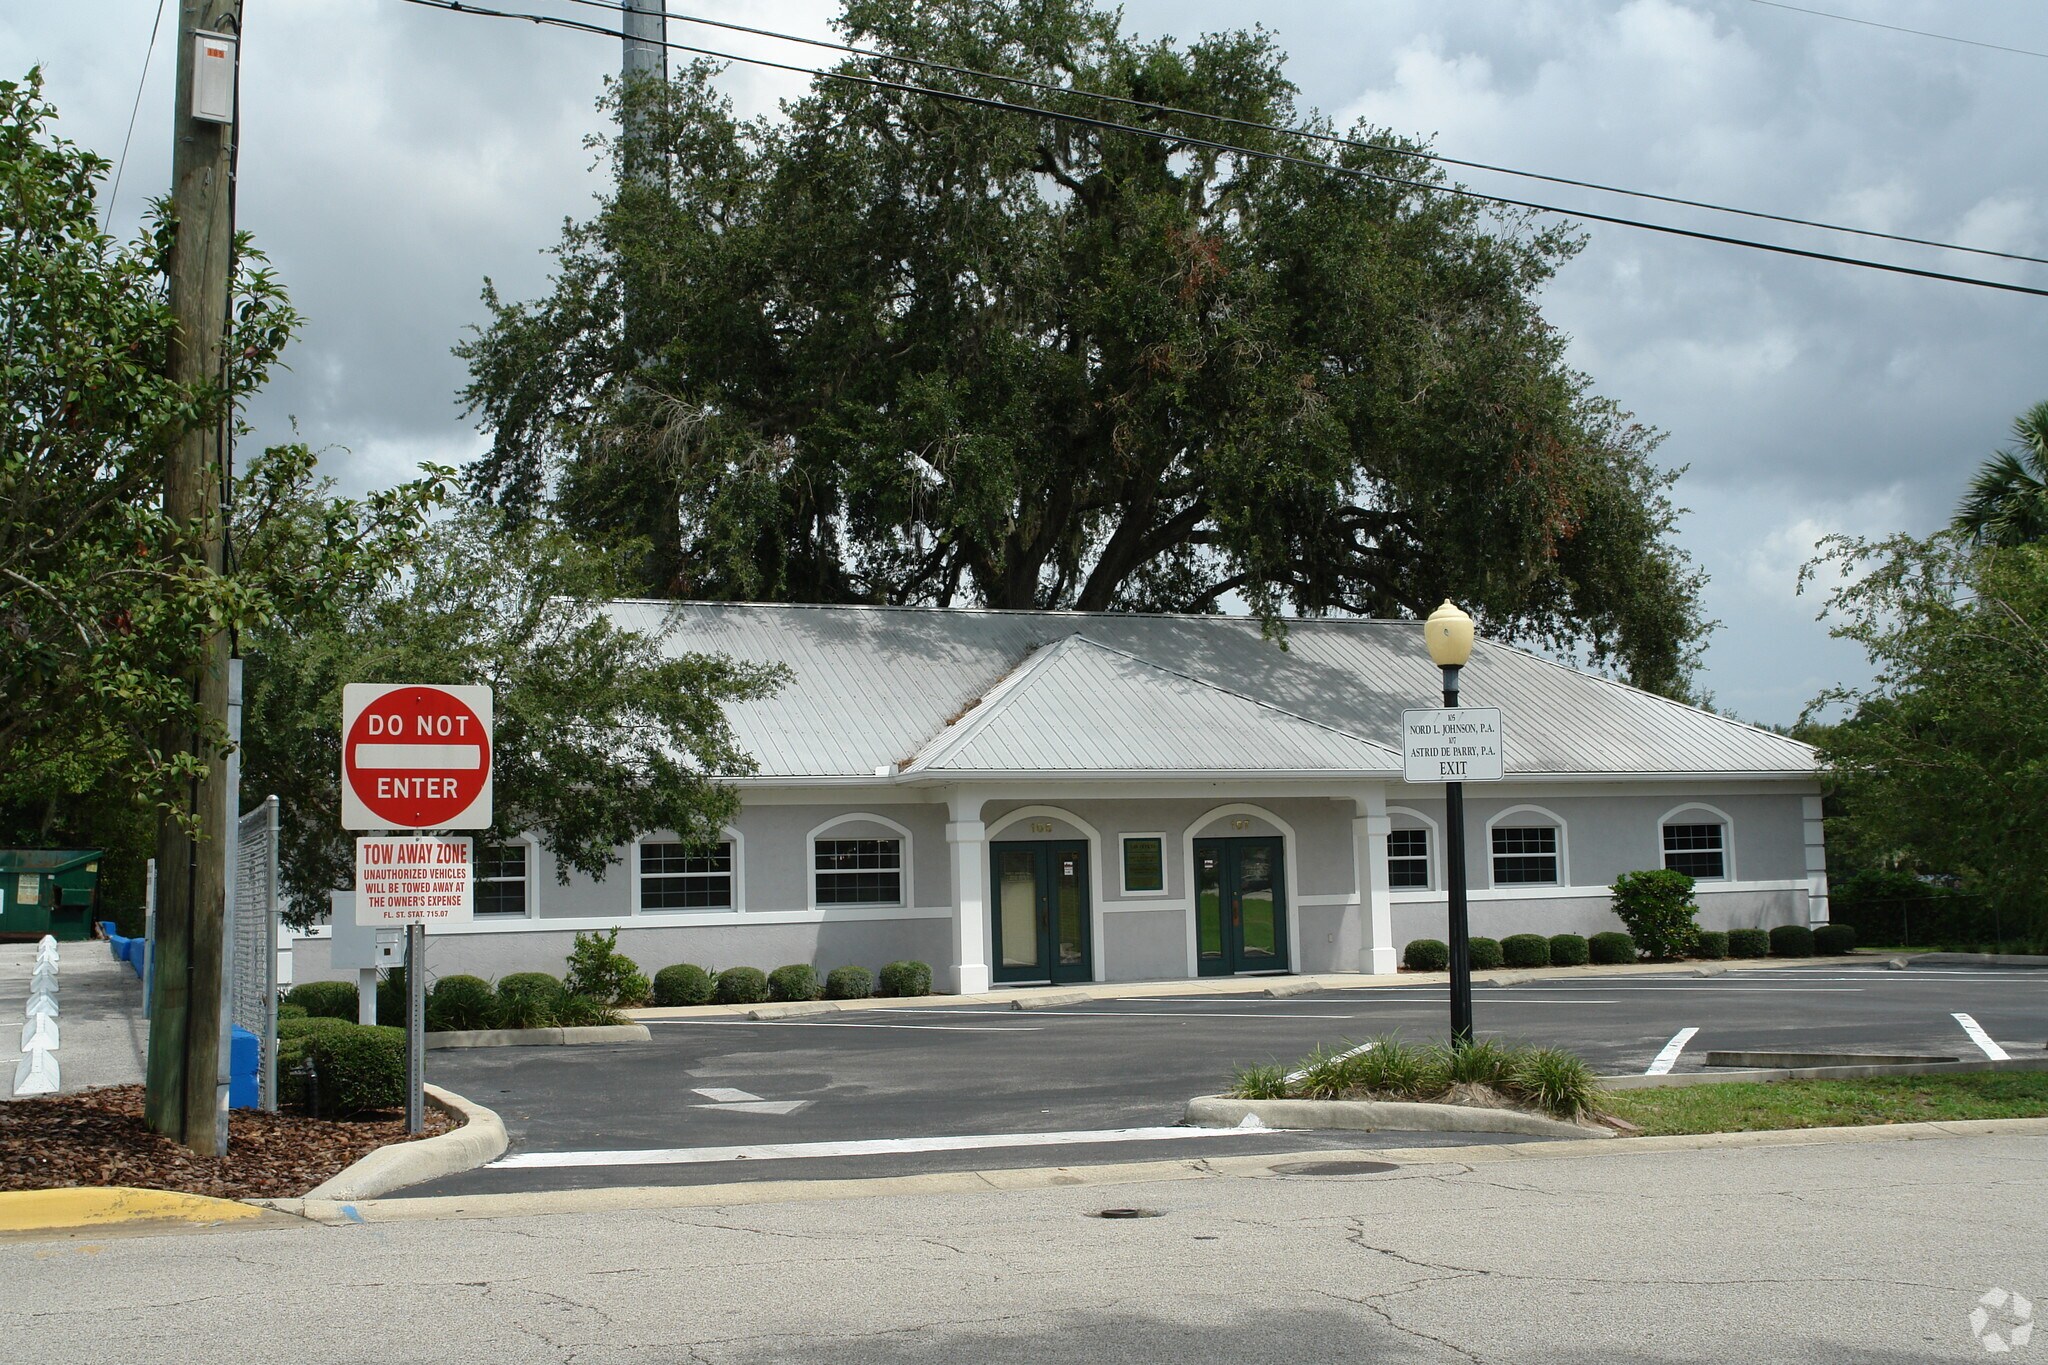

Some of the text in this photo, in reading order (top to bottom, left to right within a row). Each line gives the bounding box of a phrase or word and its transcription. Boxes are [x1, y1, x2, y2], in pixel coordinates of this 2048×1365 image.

[368, 714, 469, 736] DO NOT
[1410, 723, 1495, 736] NORD L. JOHNSON, P.A.
[1410, 746, 1496, 757] ASTRID DE PARRY, P.A.
[1440, 761, 1467, 775] EXIT
[377, 777, 458, 798] ENTER
[363, 843, 467, 865] TOW AWAY ZONE
[363, 868, 466, 880] UNAUTHORIZED VEHICLES
[365, 882, 465, 894] WILL BE TOWED AWAY AT
[369, 895, 461, 907] THE OWNER'S EXPENSE
[426, 910, 448, 918] 715.07
